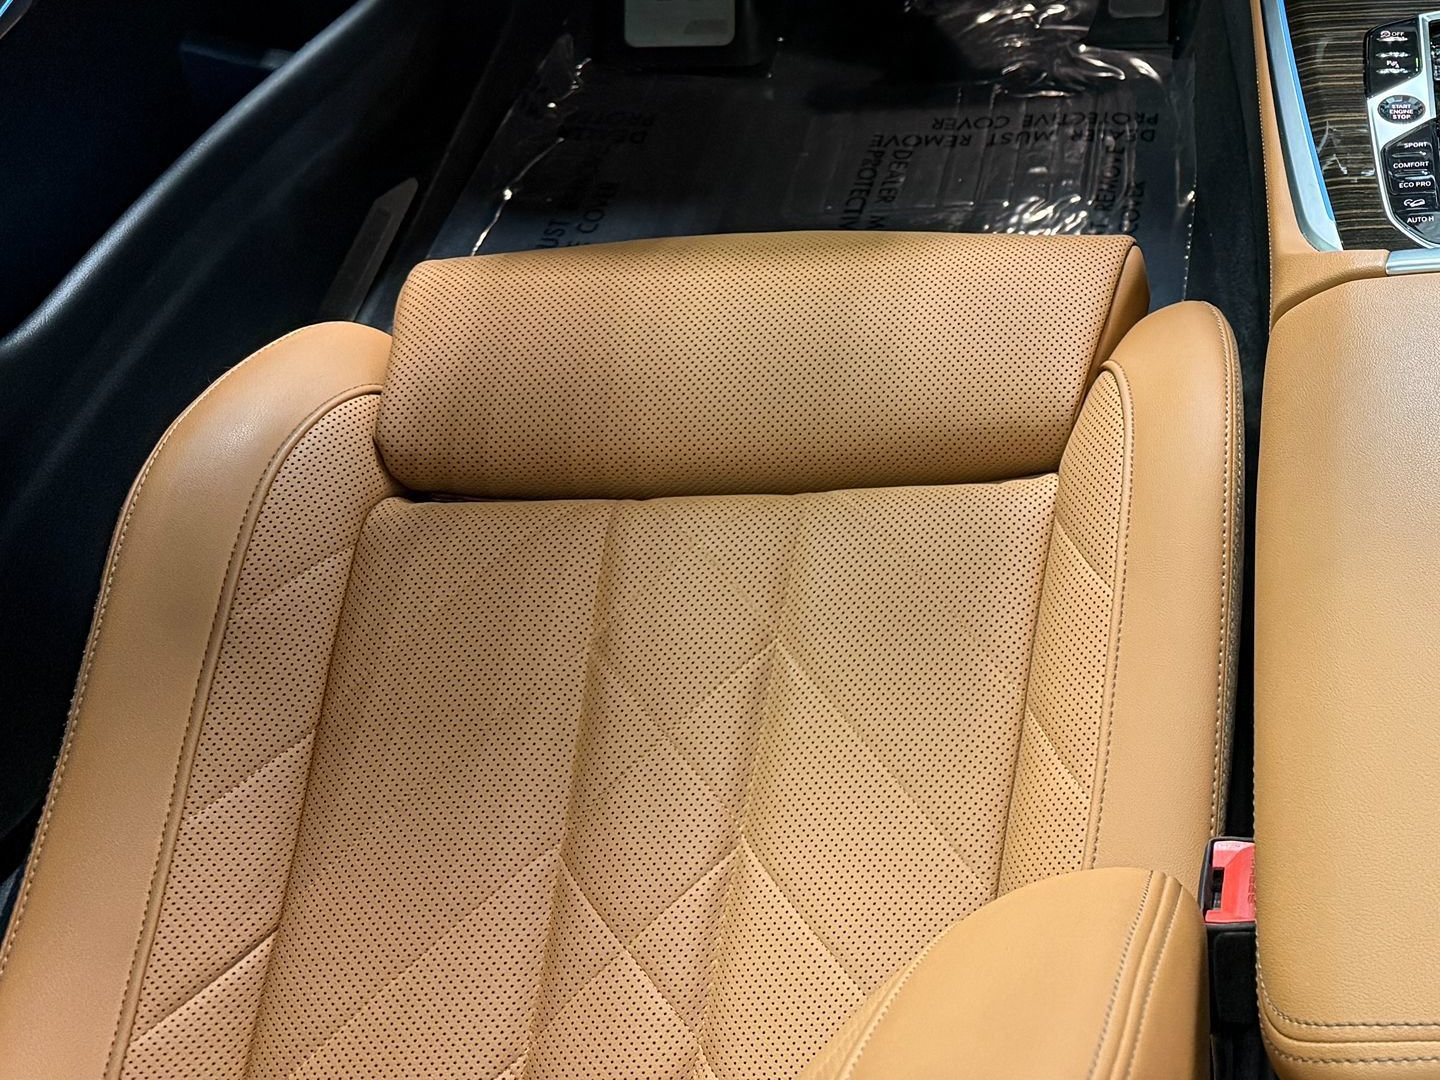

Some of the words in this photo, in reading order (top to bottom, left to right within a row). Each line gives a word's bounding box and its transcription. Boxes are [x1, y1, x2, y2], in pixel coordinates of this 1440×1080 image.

[931, 116, 1011, 132] COVER
[1022, 111, 1159, 127] PROTECTIVE
[869, 133, 973, 149] REMOVE
[986, 130, 1054, 147] MUST
[1403, 141, 1428, 149] SPORT
[1393, 161, 1430, 169] COMFORT
[876, 149, 915, 204] DEALER
[1398, 181, 1415, 189] ECO
[1415, 180, 1432, 188] PRO
[839, 149, 886, 229] PROTECTIV
[1406, 216, 1426, 224] AUTO
[535, 220, 570, 249] UST
